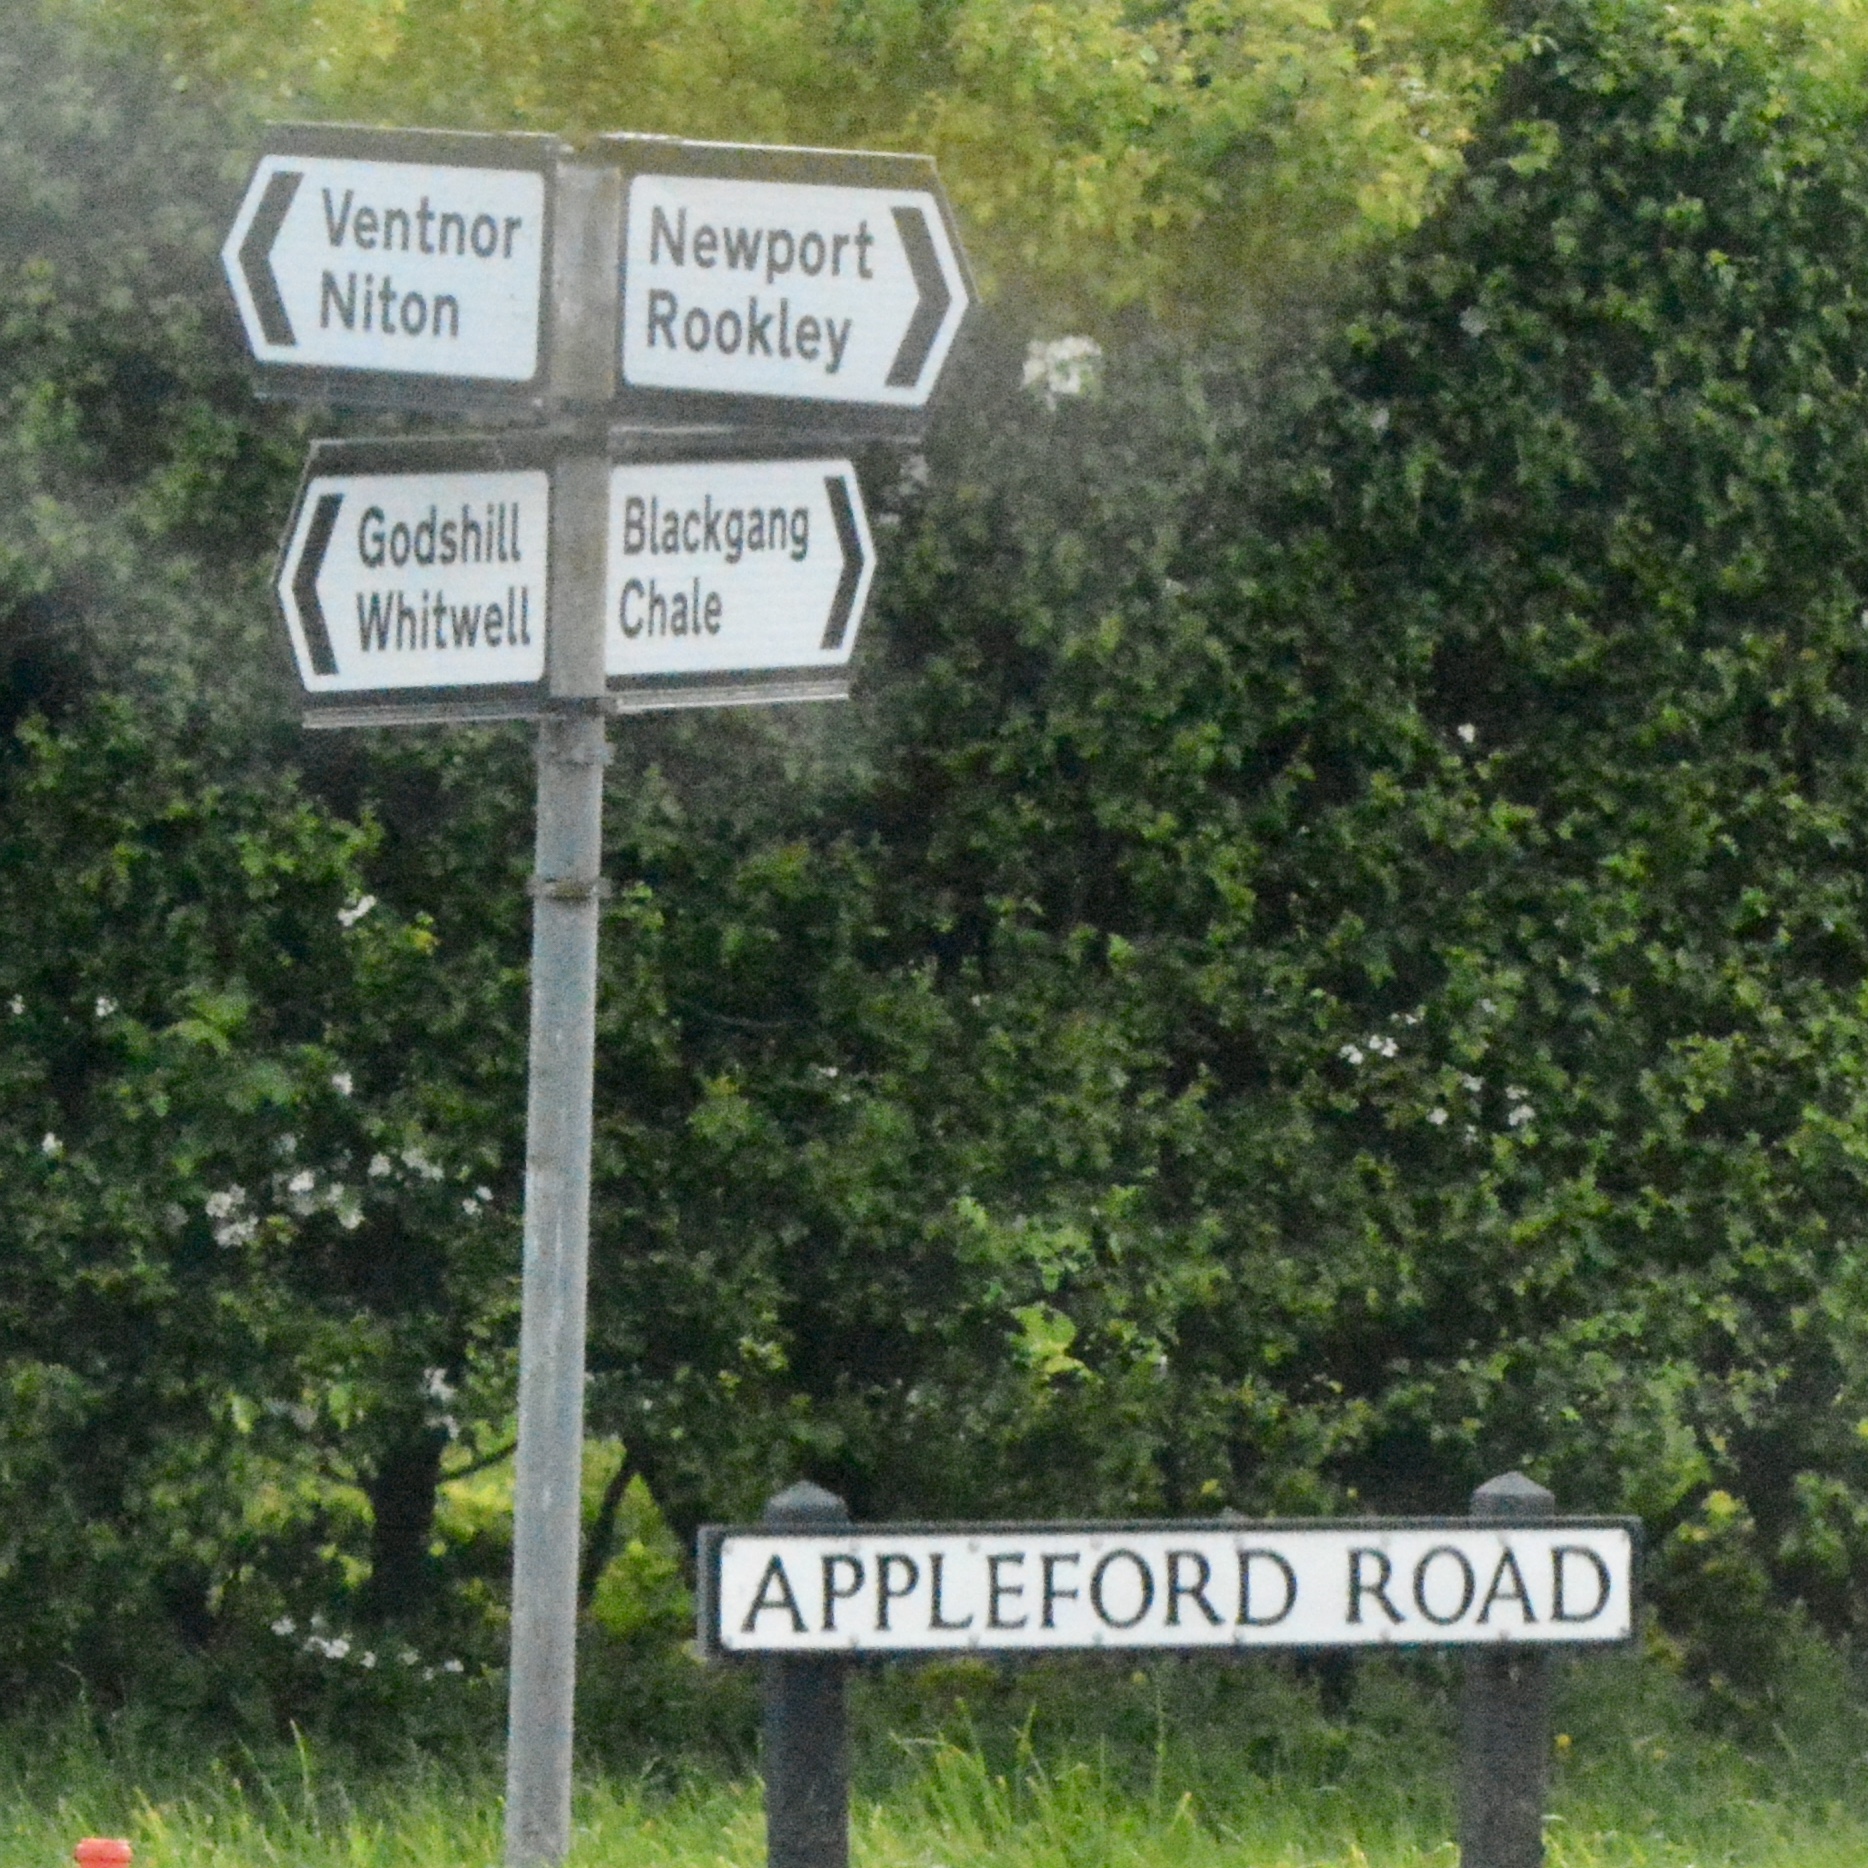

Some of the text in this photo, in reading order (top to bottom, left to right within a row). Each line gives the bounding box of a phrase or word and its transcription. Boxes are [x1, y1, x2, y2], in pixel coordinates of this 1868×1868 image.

[322, 188, 522, 259] Ventnor
[650, 206, 873, 284] Newport
[320, 271, 459, 337] Niton
[647, 289, 851, 375] Rookley
[358, 503, 520, 569] Godshill
[623, 495, 809, 564] Blackgang
[357, 587, 530, 652] Whitwell
[619, 578, 722, 639] Chale
[742, 1546, 1611, 1633] APPLEFORD ROAD
